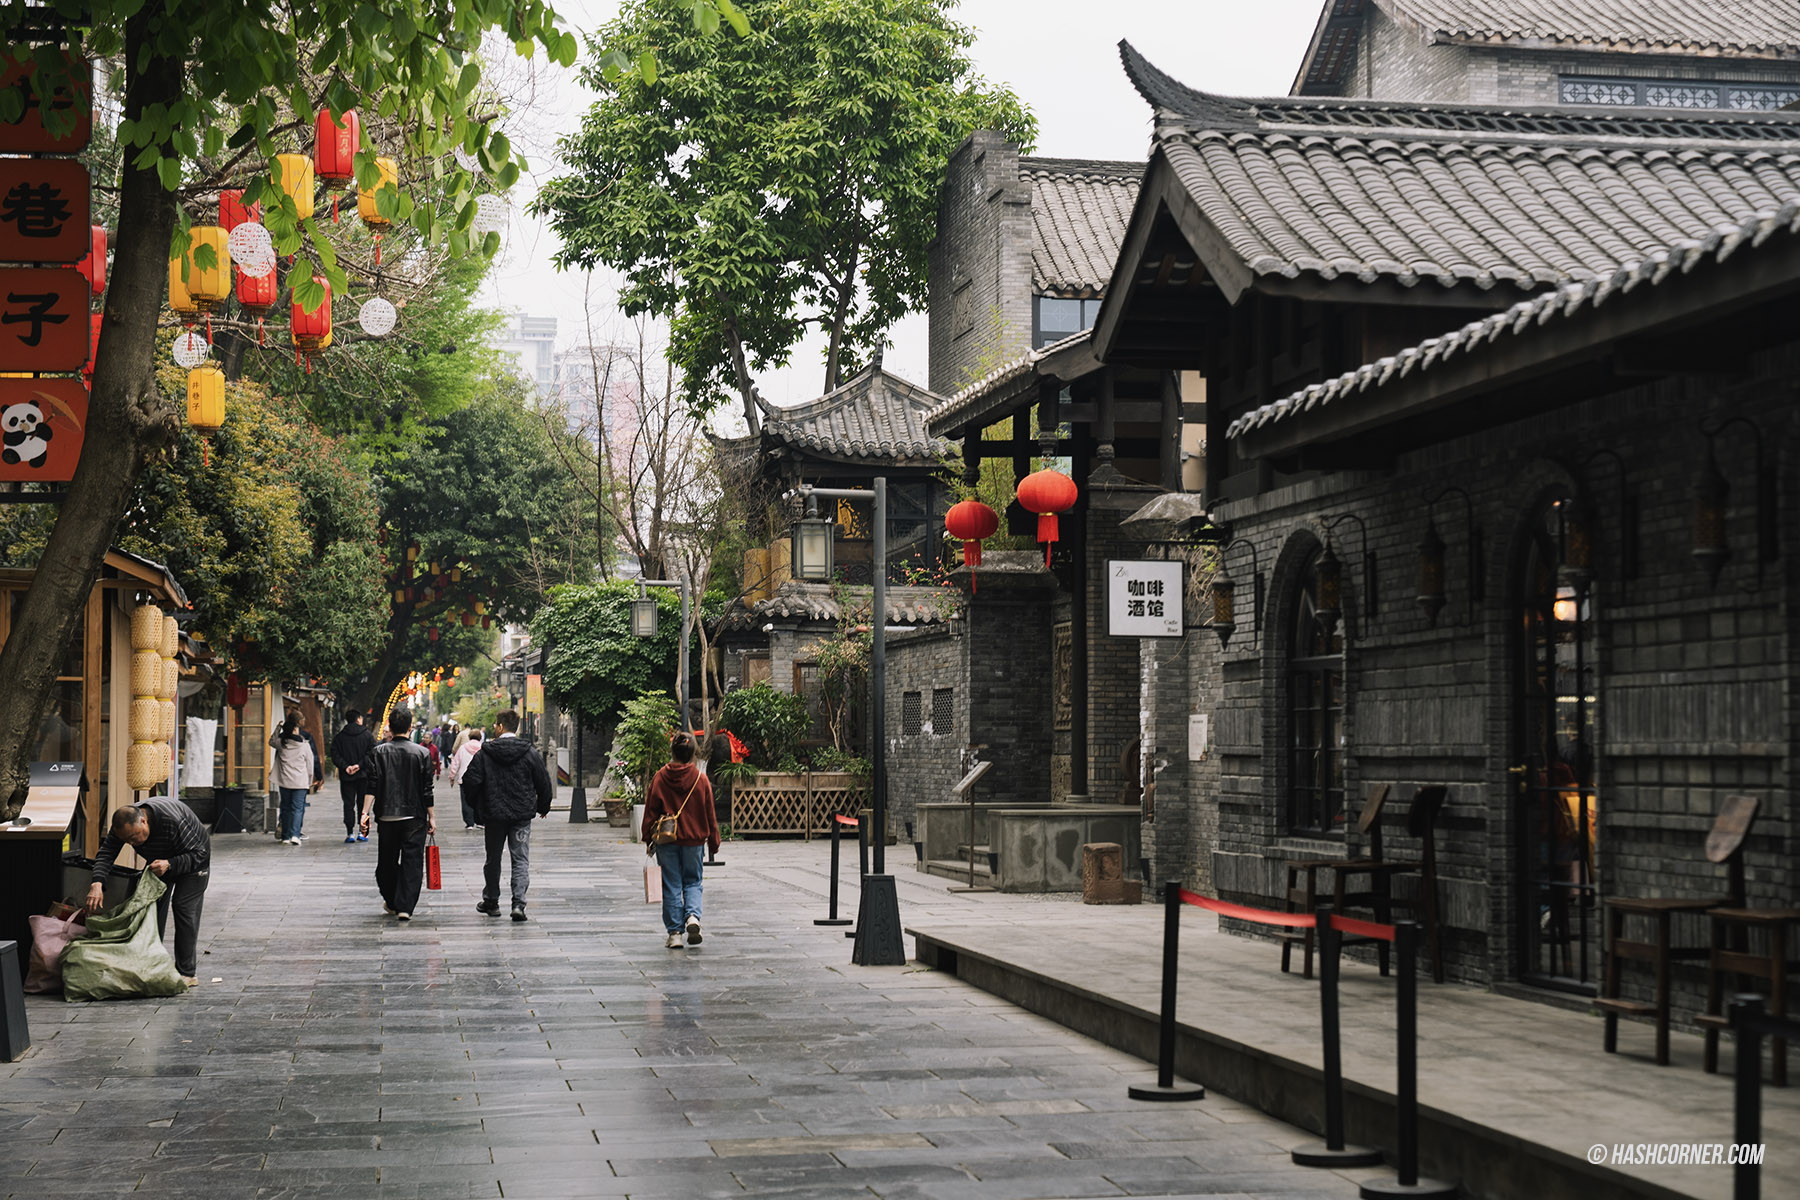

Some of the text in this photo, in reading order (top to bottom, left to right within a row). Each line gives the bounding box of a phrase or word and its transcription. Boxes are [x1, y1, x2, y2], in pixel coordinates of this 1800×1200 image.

[192, 381, 200, 411] 井巷子
[1128, 579, 1164, 597] 咖啡
[1128, 600, 1164, 617] 酒馆
